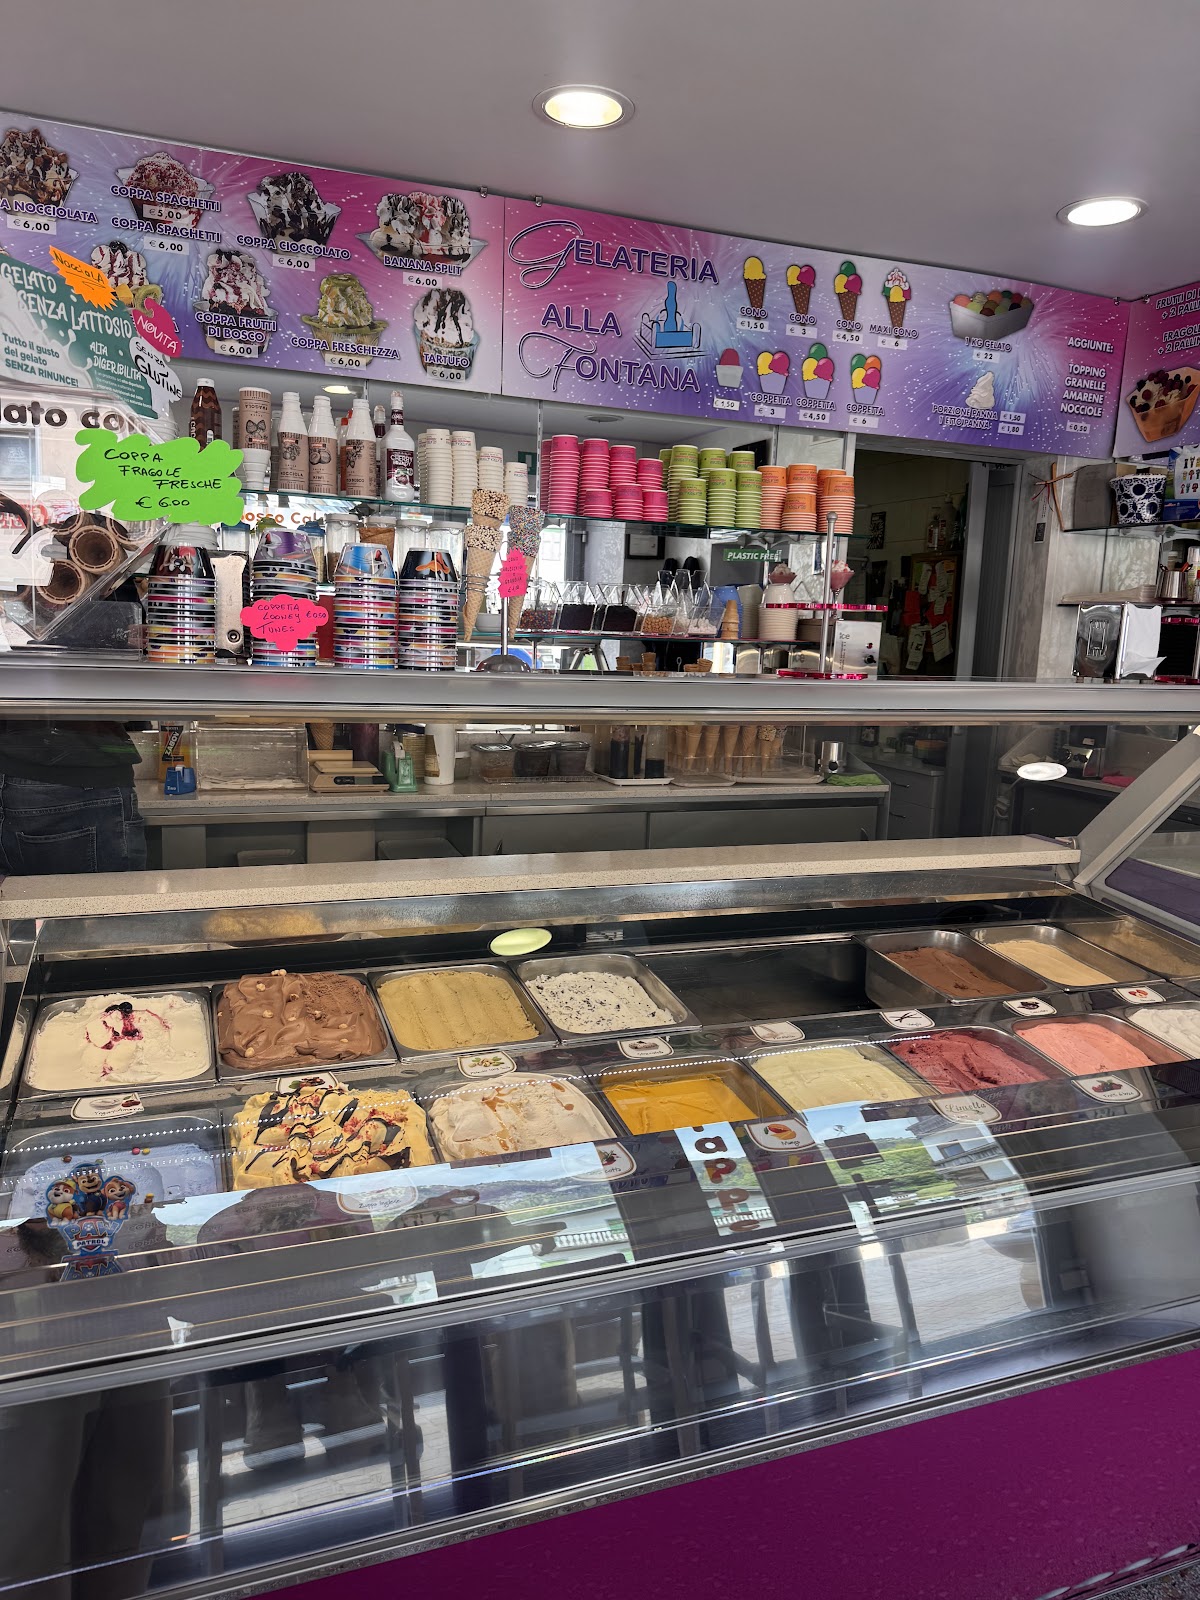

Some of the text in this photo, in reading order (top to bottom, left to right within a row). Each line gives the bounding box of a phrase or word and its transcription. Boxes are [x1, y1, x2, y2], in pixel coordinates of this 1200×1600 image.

[110, 186, 222, 212] COPPA SPAGHETTI
[14, 200, 98, 224] NOCCIOLATA
[111, 216, 221, 243] COPPA SPAGHETTI
[236, 234, 351, 260] COPPA CIOCCOLATO
[508, 219, 719, 289] GELATERIA
[384, 256, 462, 277] BANANA SPLIT
[0, 262, 57, 294] GELATO
[1156, 292, 1186, 310] FRUTTI
[1186, 289, 1197, 301] DI
[16, 289, 69, 322] SENZA
[70, 306, 134, 339] LATTOSIO
[540, 303, 622, 337] ALLA
[740, 306, 768, 319] CONO
[788, 313, 817, 325] CONO
[1170, 307, 1177, 318] 2
[195, 312, 235, 327] COPPA
[238, 317, 278, 332] FRUTTI
[836, 319, 863, 331] CONO
[208, 326, 266, 343] DI BOSCO
[801, 328, 807, 336] 3
[869, 324, 919, 340] MAXI CONO
[2, 332, 60, 360] Tutto il gusto
[90, 341, 109, 357] ALTA
[290, 336, 401, 361] COPPA FRESCHEZZA
[894, 340, 900, 348] 6
[971, 338, 984, 348] KG
[984, 340, 1013, 353] GELATO
[1067, 336, 1114, 353] AGGIUNTE:
[1165, 342, 1173, 354] 2
[4, 345, 48, 367] del gelato
[136, 341, 167, 369] SENZA
[422, 352, 471, 369] TARTUFO
[518, 332, 701, 393] FONTANA
[984, 352, 994, 360] 22
[5, 359, 37, 376] SENZA
[38, 366, 79, 388] RINUNCE!
[134, 354, 183, 399] GLUTINE
[1068, 363, 1106, 379] TOPPING
[1064, 376, 1107, 391] GRANELLE
[750, 392, 792, 406] COPPETTA
[795, 398, 837, 411] COPPETTA
[1062, 390, 1104, 405] AMARENE
[0, 400, 68, 427] ato
[770, 408, 776, 416] 3
[846, 404, 886, 416] COPPETTA
[932, 404, 998, 421] PORZIONE PANNA
[1060, 403, 1103, 417] NOCCIOLE
[944, 417, 963, 427] ETTO
[104, 448, 164, 463] COPPA
[390, 454, 413, 463] CHERRY
[118, 464, 183, 477] FRAGOLE
[152, 478, 223, 491] FRESCHE
[135, 496, 153, 510] €
[727, 552, 780, 561] PLASTIC FREE
[257, 603, 300, 612] COPPETTA
[262, 612, 301, 624] LOONEY
[256, 621, 296, 635] TUNES
[165, 732, 180, 756] ZABOV
[63, 1220, 119, 1241] PAW
